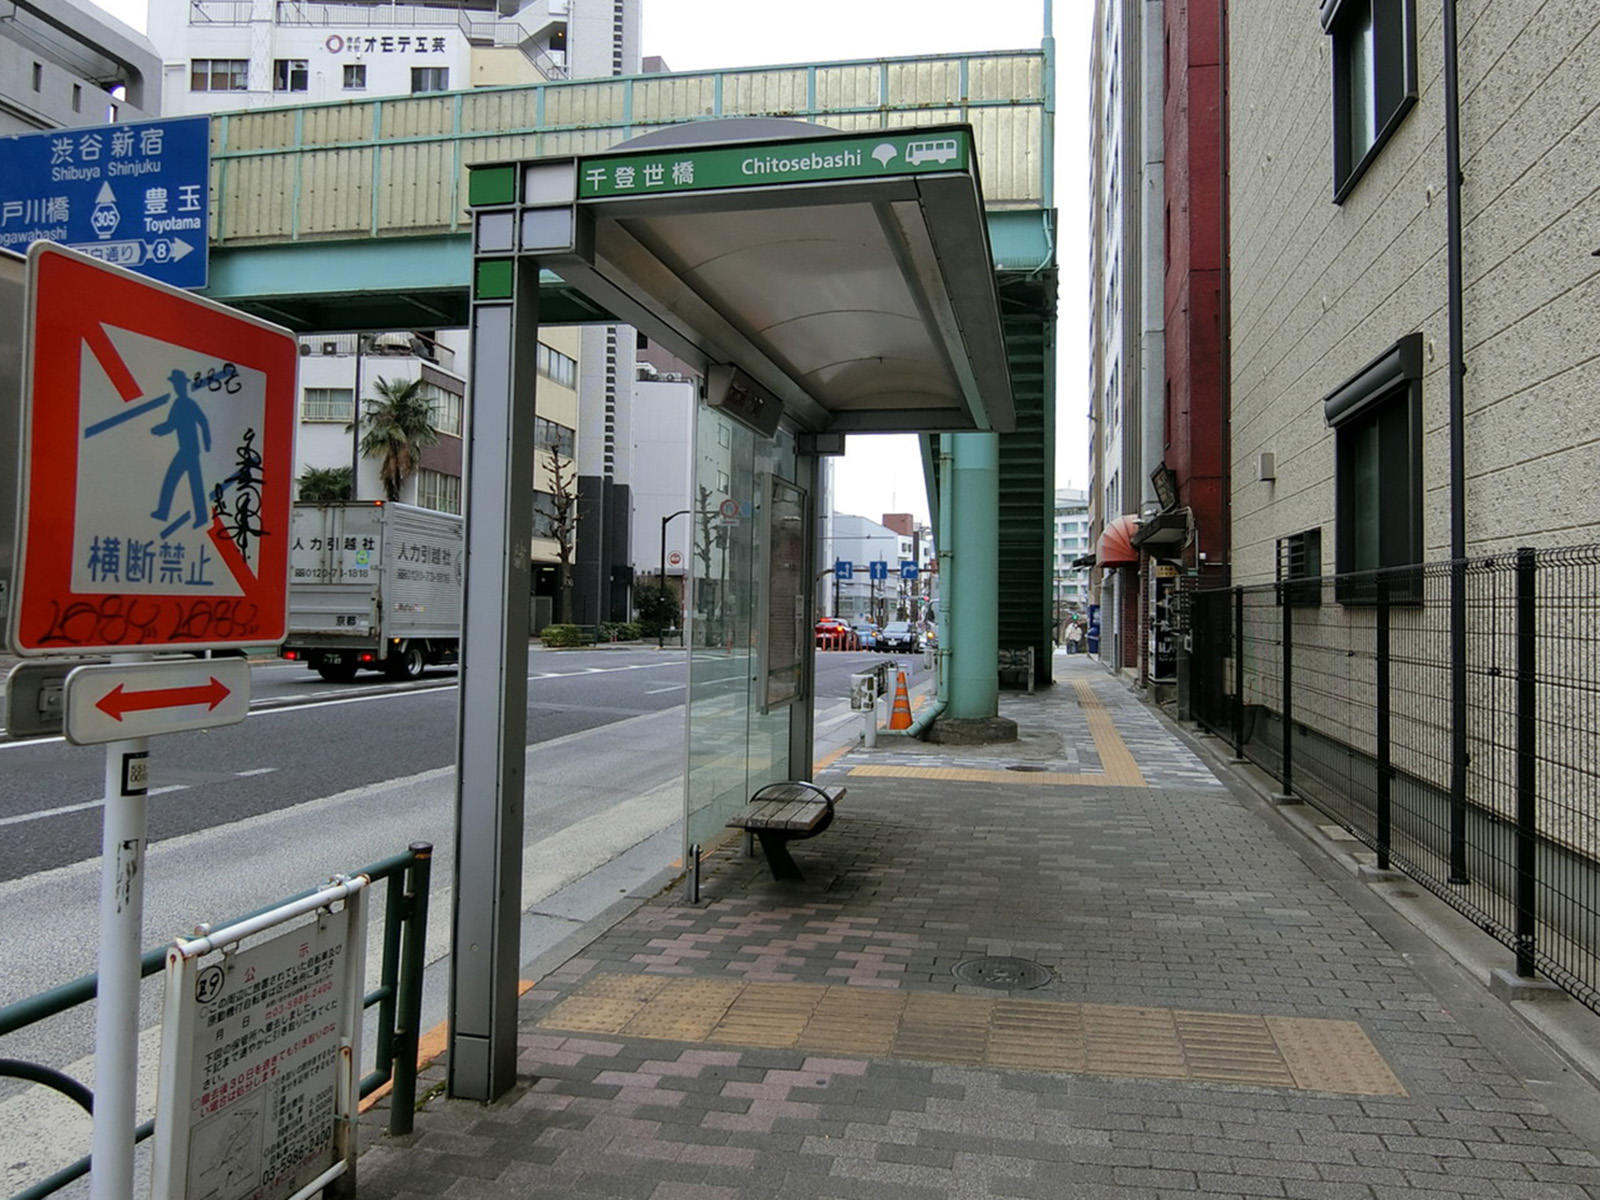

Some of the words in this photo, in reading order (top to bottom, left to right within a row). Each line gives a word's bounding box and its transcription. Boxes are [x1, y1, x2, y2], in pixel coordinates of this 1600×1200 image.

[364, 36, 446, 53] オモテ工芸
[50, 133, 103, 165] 渋谷
[110, 127, 164, 158] 新宿
[51, 165, 101, 182] Shibuya
[107, 160, 162, 177] Shinjuku
[741, 150, 862, 175] Chitosebashi
[586, 161, 694, 191] 千登世橋
[1, 196, 70, 227] 戸川橋
[143, 185, 202, 215] 豊玉
[94, 212, 117, 228] 305
[143, 216, 202, 234] Toyotama
[156, 244, 167, 258] 8
[292, 537, 375, 551] 人力引越社
[397, 541, 452, 566] 人力引越社
[87, 535, 215, 586] 横断禁止
[215, 1027, 224, 1042] 月
[242, 1014, 249, 1029] 日
